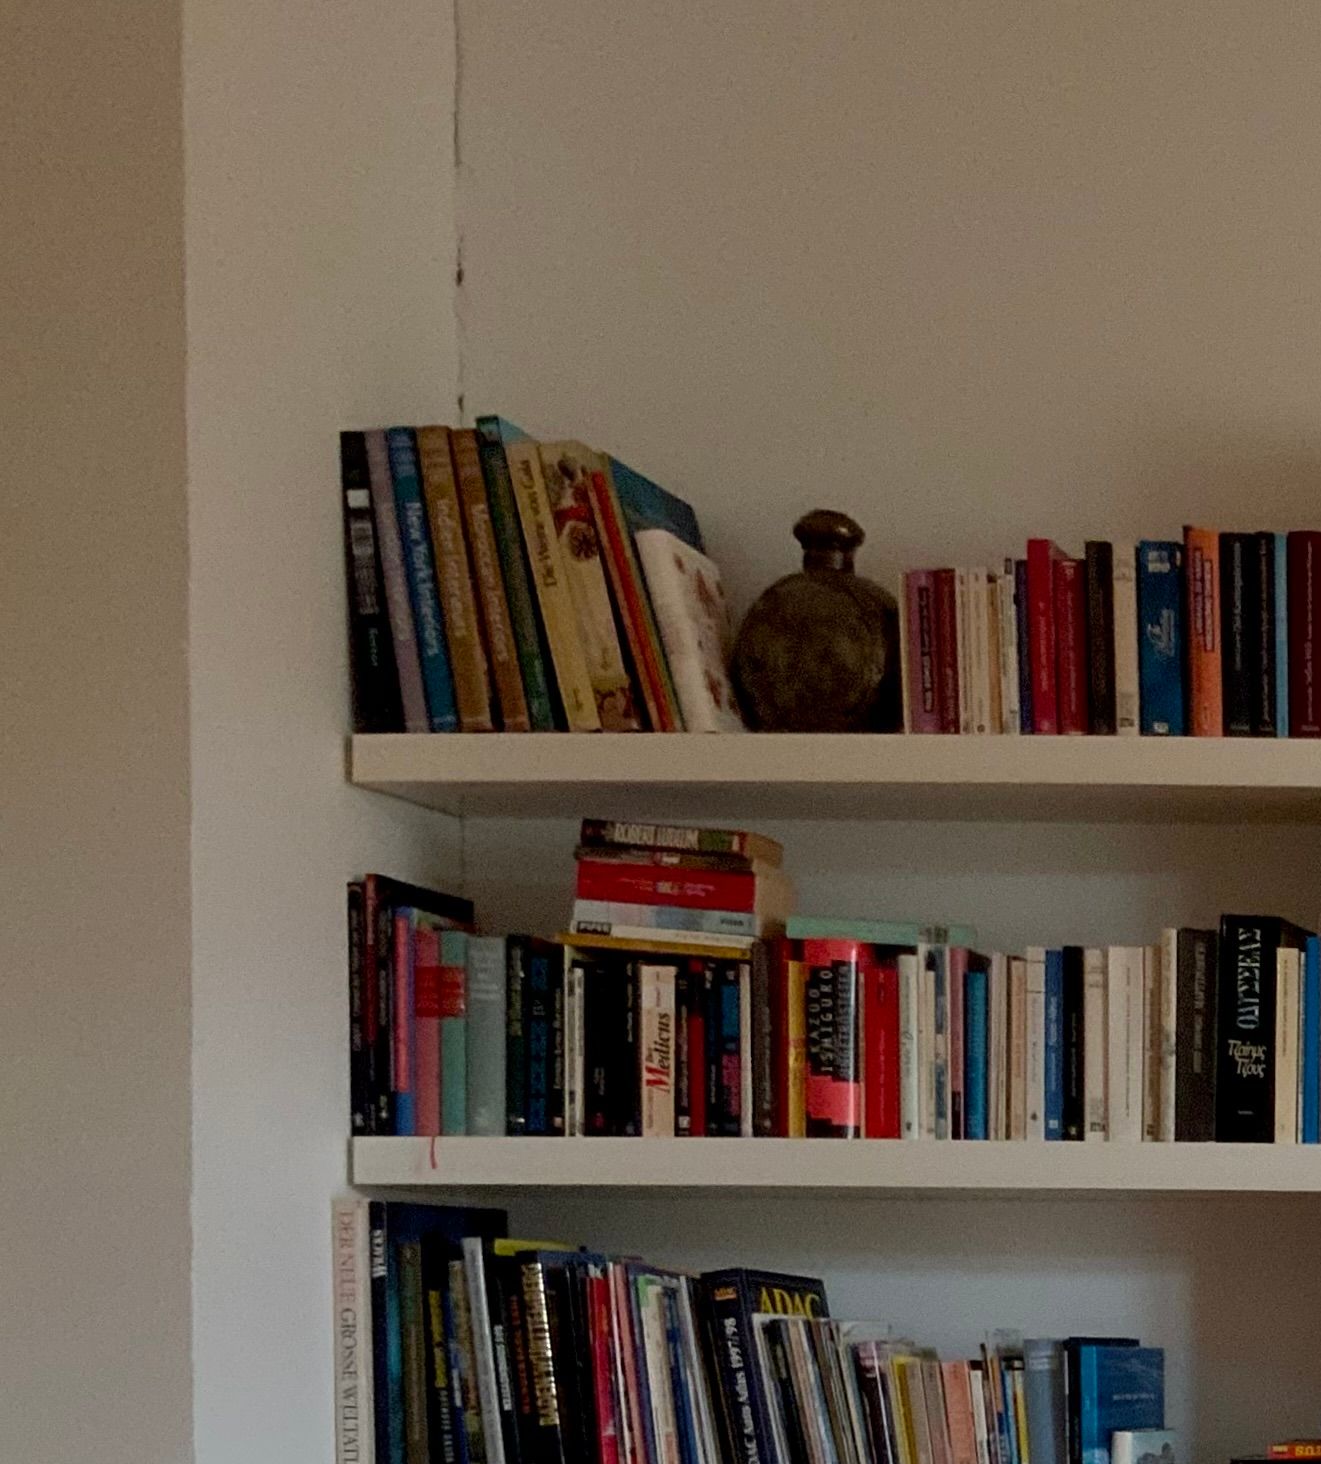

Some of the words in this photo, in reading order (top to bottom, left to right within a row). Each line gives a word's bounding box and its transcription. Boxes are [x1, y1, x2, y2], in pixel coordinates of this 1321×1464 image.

[405, 504, 425, 533] New
[408, 536, 430, 579] York
[413, 583, 439, 657] Interiors
[808, 987, 821, 1054] KAZUO
[644, 1011, 673, 1094] Medicus
[338, 1211, 355, 1249] DER
[339, 1252, 356, 1304] NEUE
[760, 1287, 819, 1315] ADAC
[340, 1306, 358, 1379] GROSSE
[734, 1371, 750, 1403] Atlas
[740, 1405, 754, 1436] Auto
